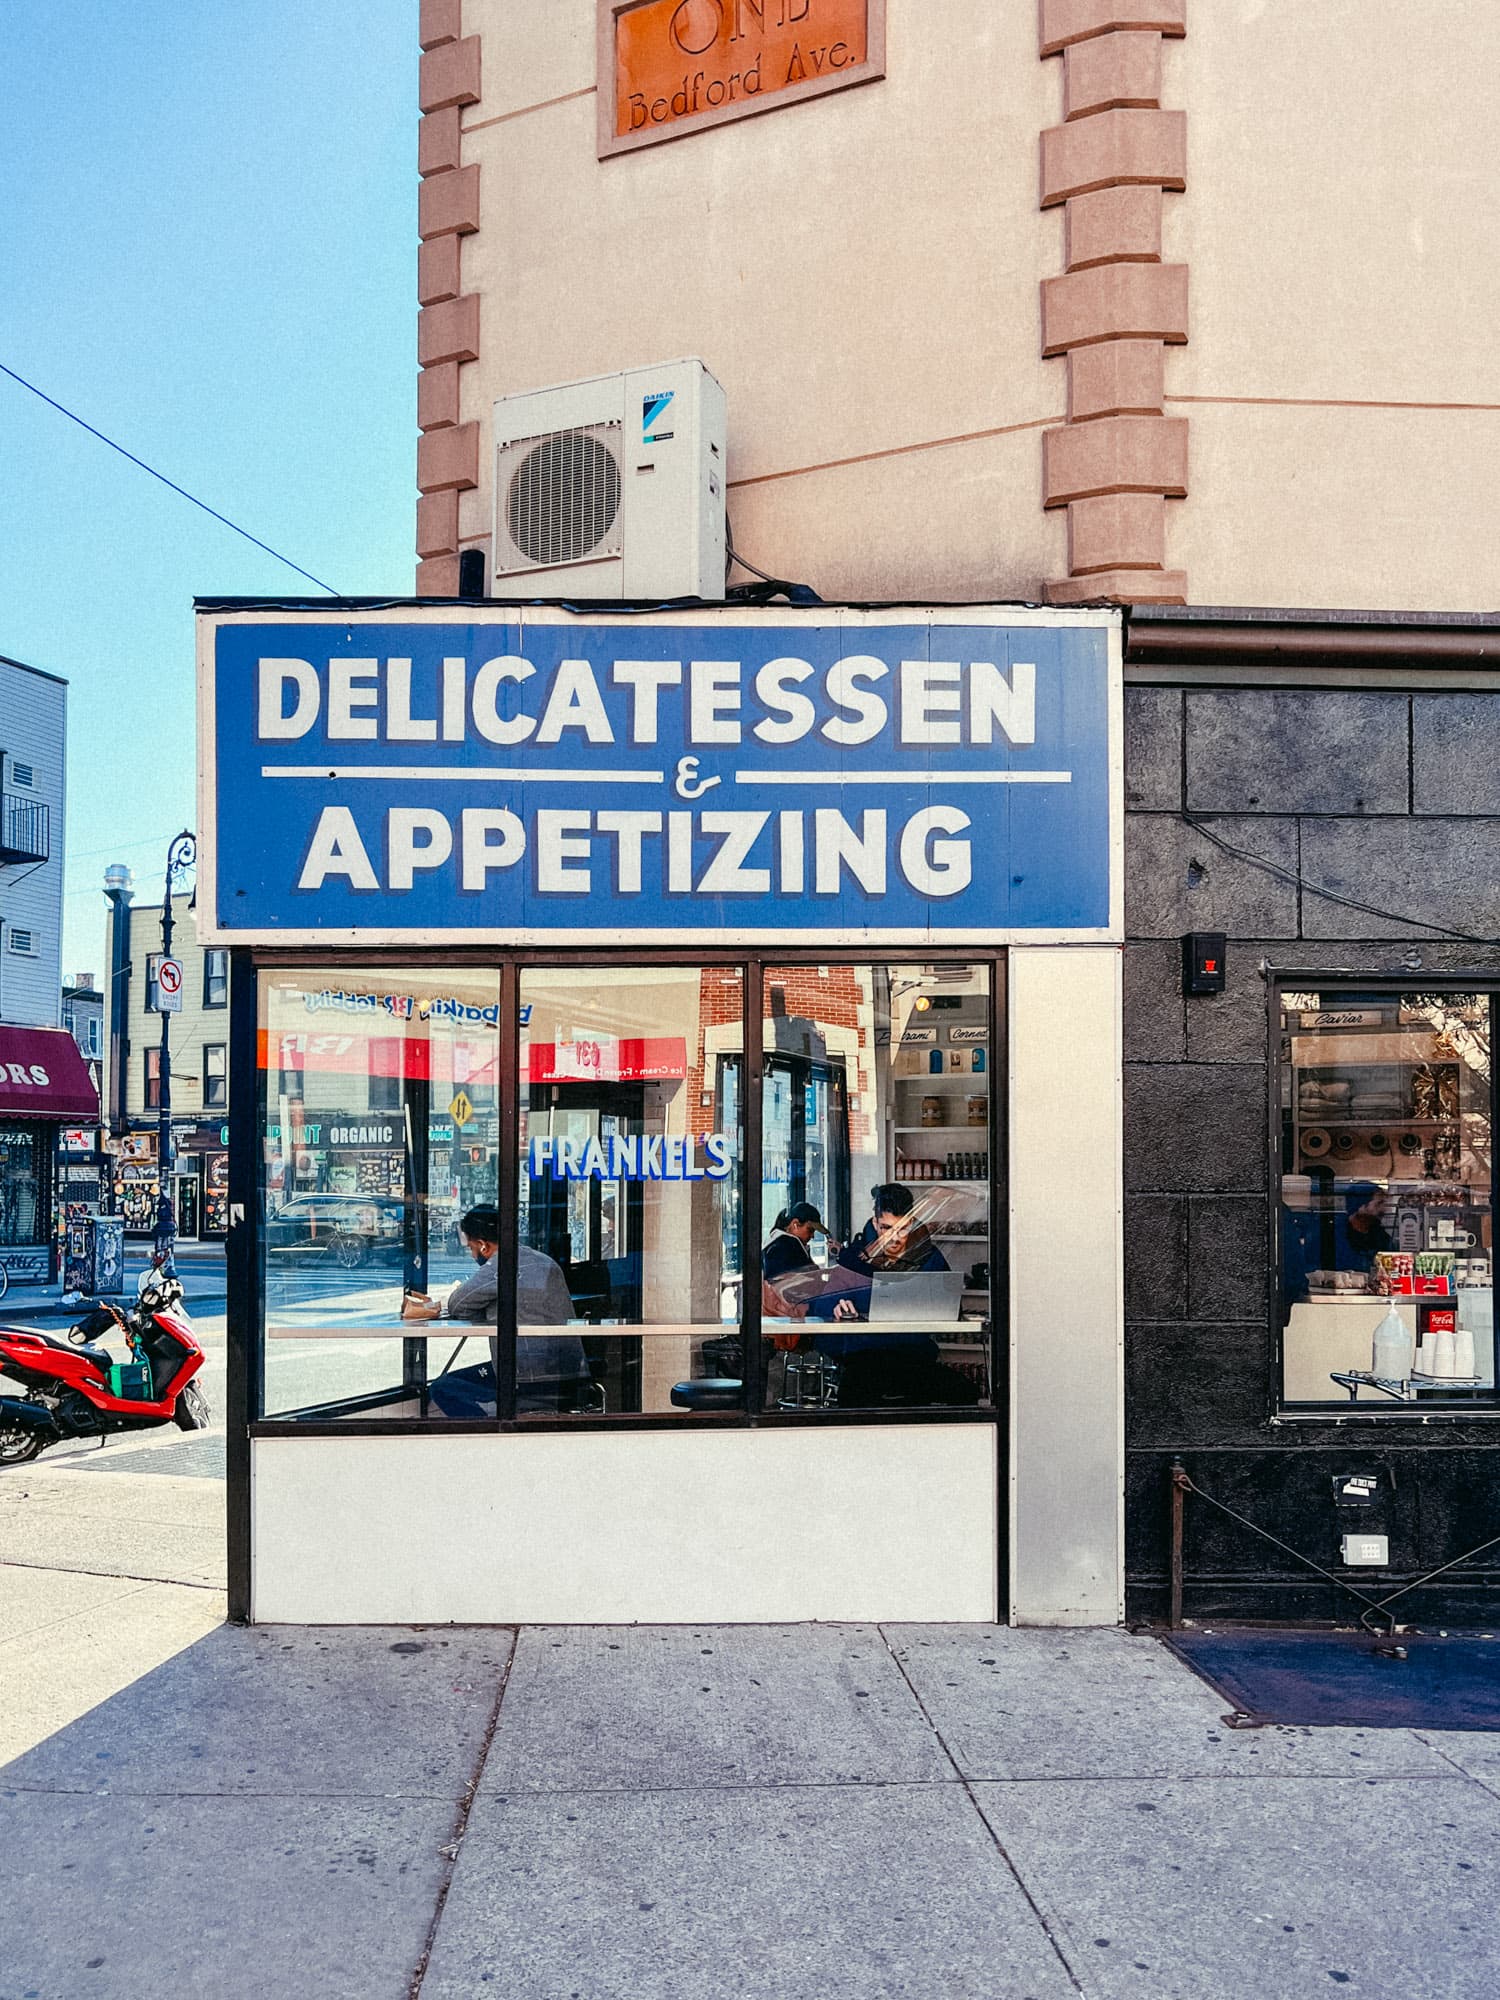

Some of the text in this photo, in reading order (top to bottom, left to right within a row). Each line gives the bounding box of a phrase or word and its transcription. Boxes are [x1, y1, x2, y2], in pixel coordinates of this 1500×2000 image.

[628, 42, 856, 131] Bedford Ave.
[643, 391, 675, 402] DAIKIN
[257, 654, 1037, 746] DELICATESSEN
[676, 756, 722, 801] &
[297, 804, 973, 898] APPETIZING
[1314, 1012, 1364, 1026] Caviar
[330, 1126, 393, 1144] ORGANIC
[530, 1133, 733, 1182] FRANKEL'S
